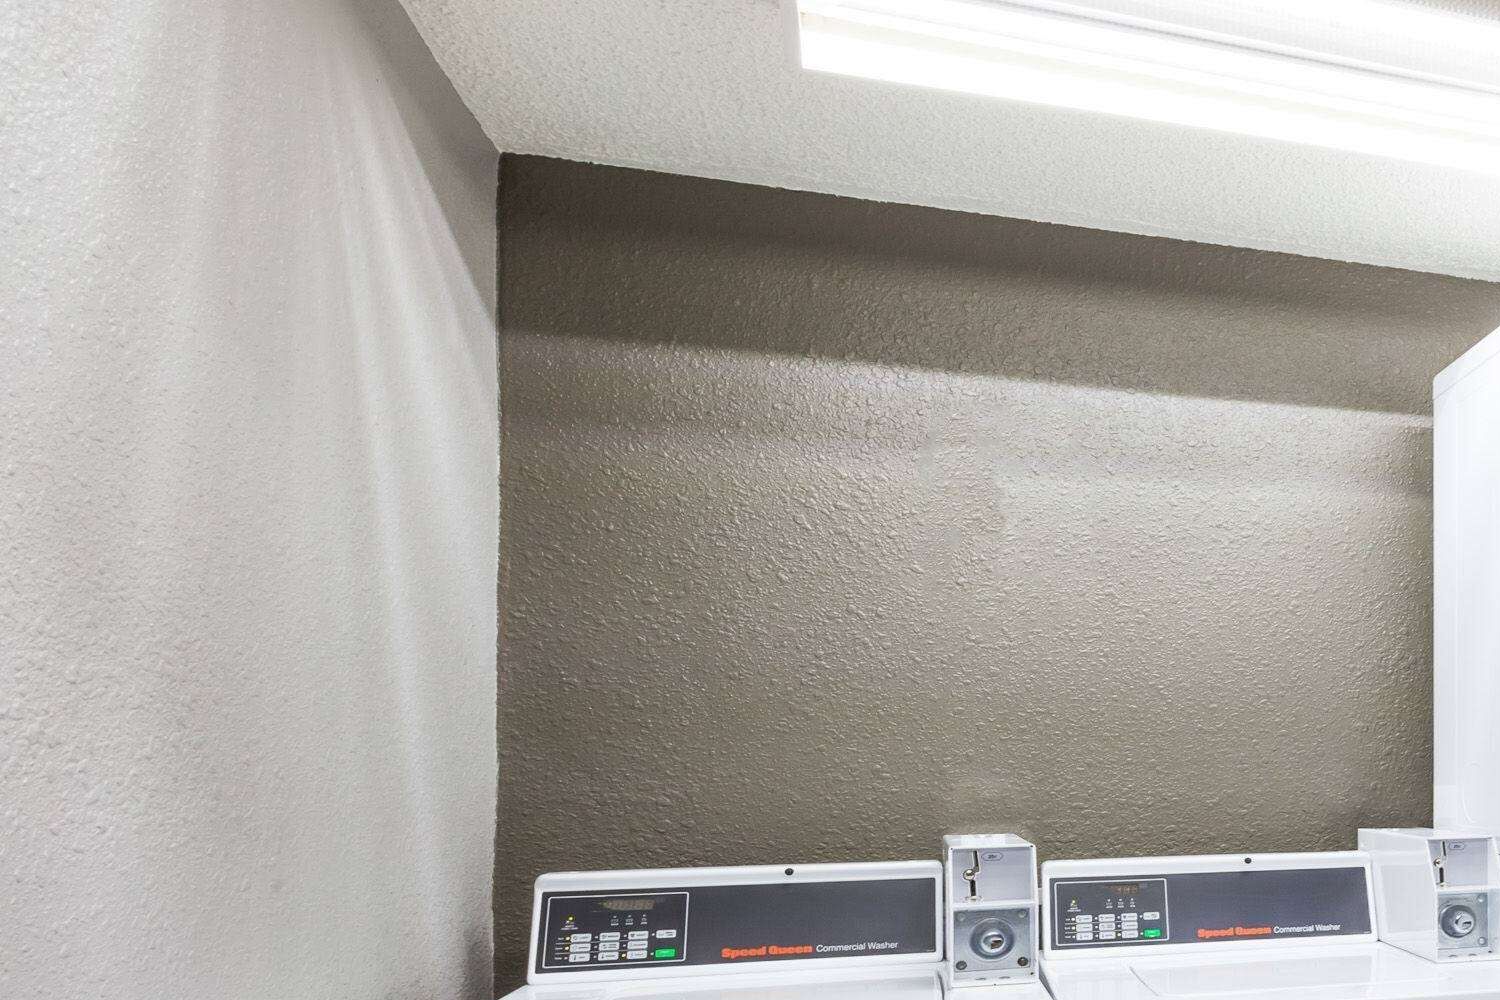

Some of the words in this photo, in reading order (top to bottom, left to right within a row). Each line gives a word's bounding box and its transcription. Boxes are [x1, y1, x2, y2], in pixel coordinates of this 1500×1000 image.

[1197, 927, 1235, 939] Speed
[1273, 924, 1315, 934] Commercial
[1315, 923, 1341, 932] Washer
[721, 946, 766, 960] Speed
[768, 944, 813, 956] Queen
[816, 942, 867, 953] Commercial
[867, 941, 898, 951] Washer
